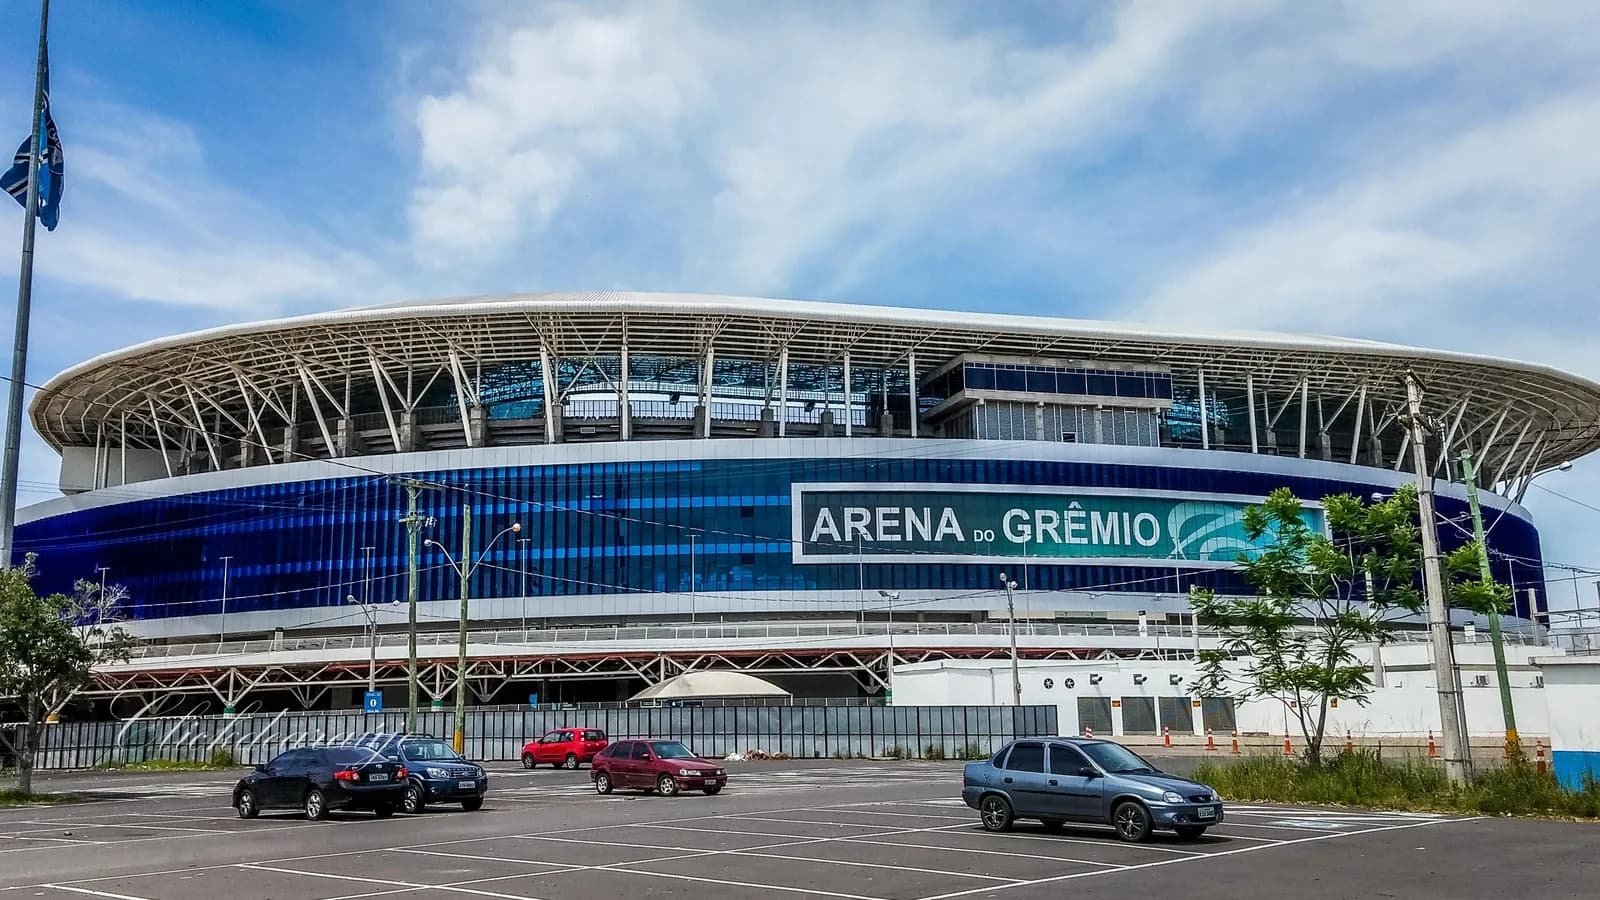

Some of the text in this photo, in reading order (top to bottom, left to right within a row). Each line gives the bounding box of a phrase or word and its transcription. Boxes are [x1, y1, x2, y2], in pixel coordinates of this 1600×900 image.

[809, 501, 1161, 547] ARENA DO GRÊMIO
